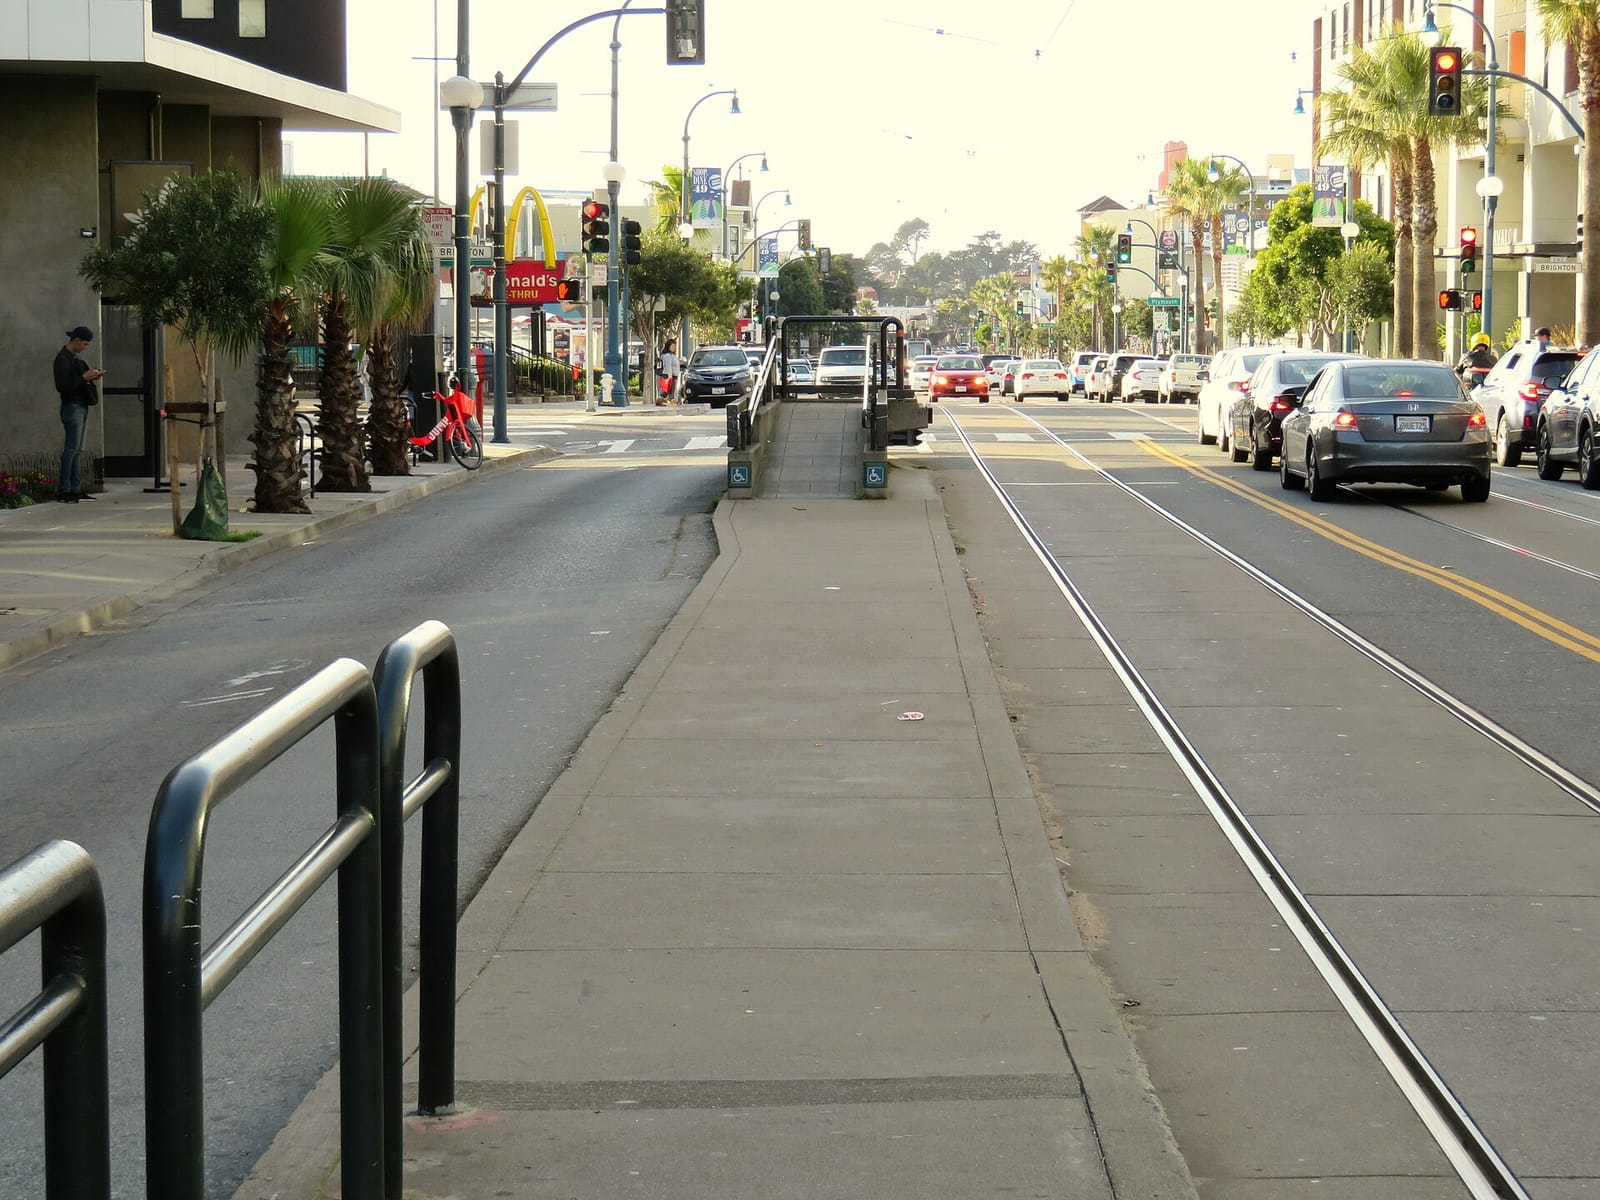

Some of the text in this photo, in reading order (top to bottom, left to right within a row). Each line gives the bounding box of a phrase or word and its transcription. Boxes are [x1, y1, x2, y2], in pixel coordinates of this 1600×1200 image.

[693, 176, 708, 185] DINE
[693, 184, 708, 193] 49
[440, 248, 485, 256] BRION
[505, 275, 557, 287] nald's
[505, 290, 539, 299] -THRU
